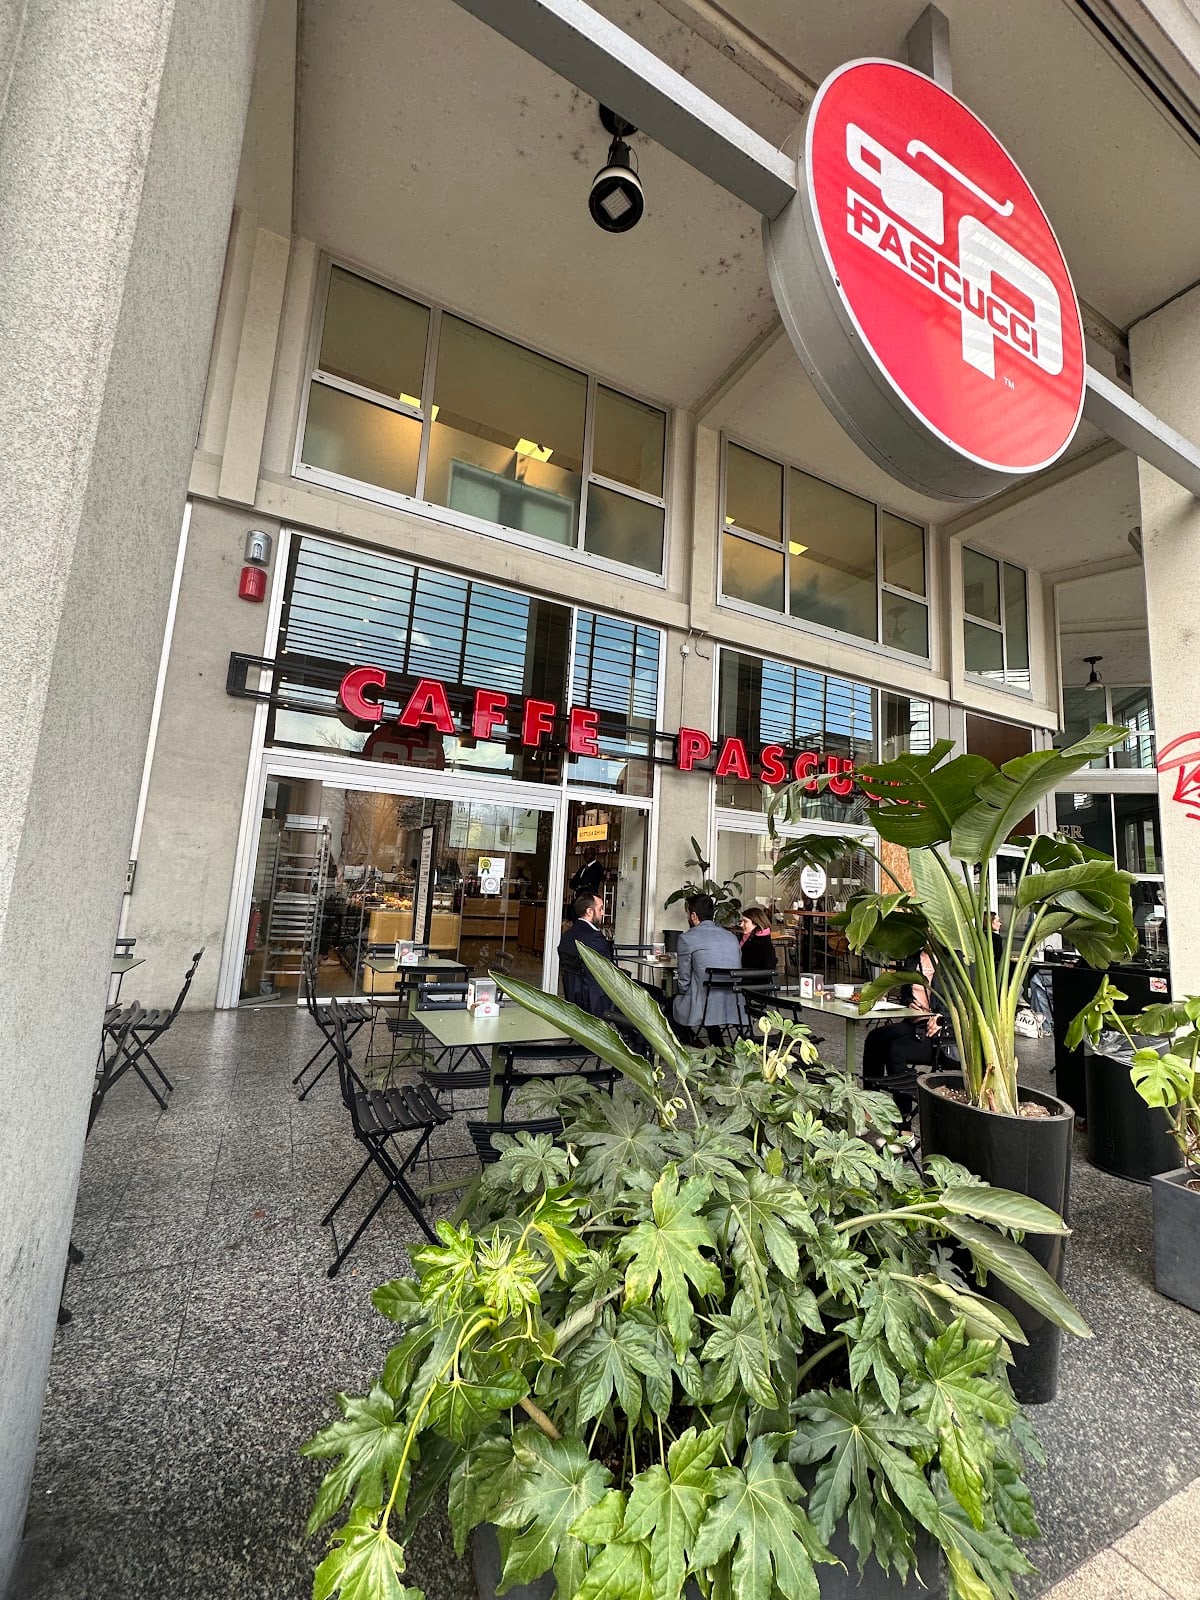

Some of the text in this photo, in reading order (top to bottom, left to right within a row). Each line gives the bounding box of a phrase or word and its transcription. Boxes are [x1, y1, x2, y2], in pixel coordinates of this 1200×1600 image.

[847, 197, 1039, 360] PASCUCCI
[339, 664, 927, 809] CAFFE PASCU
